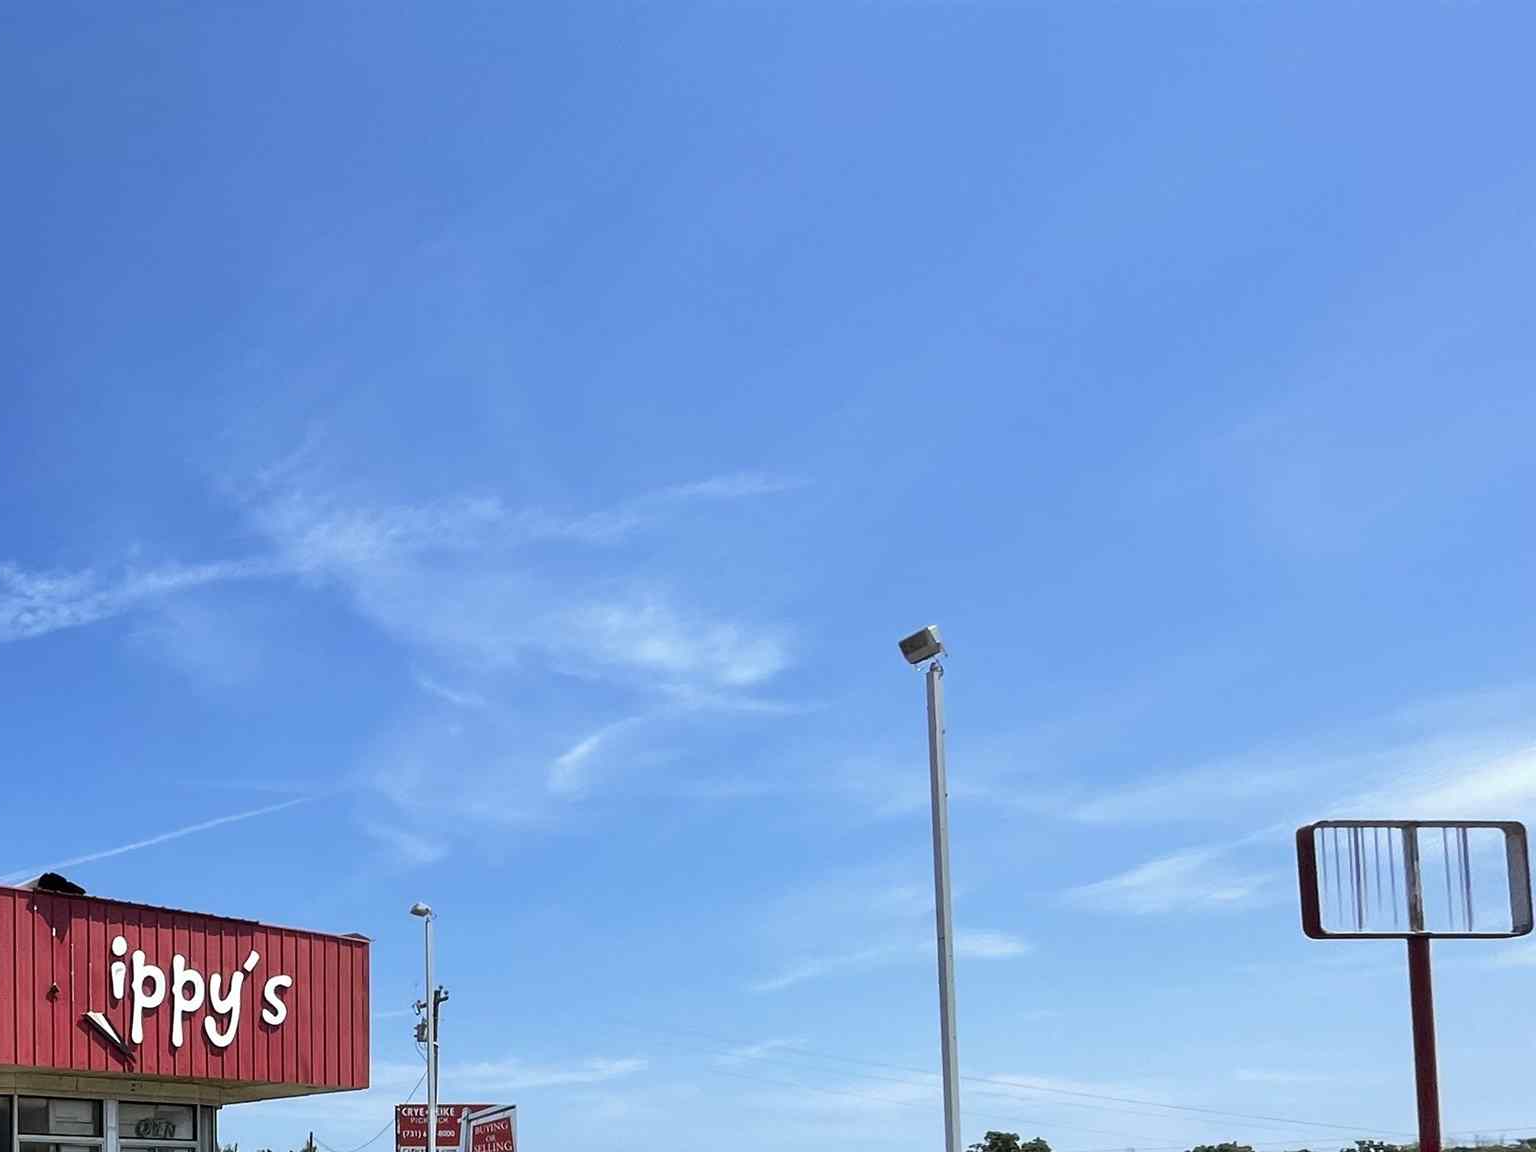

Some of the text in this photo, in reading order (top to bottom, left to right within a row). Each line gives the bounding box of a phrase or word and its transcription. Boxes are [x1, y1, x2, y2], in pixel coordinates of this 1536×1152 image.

[111, 936, 293, 1048] ippy's
[475, 1121, 508, 1135] BUYING
[474, 1141, 513, 1152] SELLING
